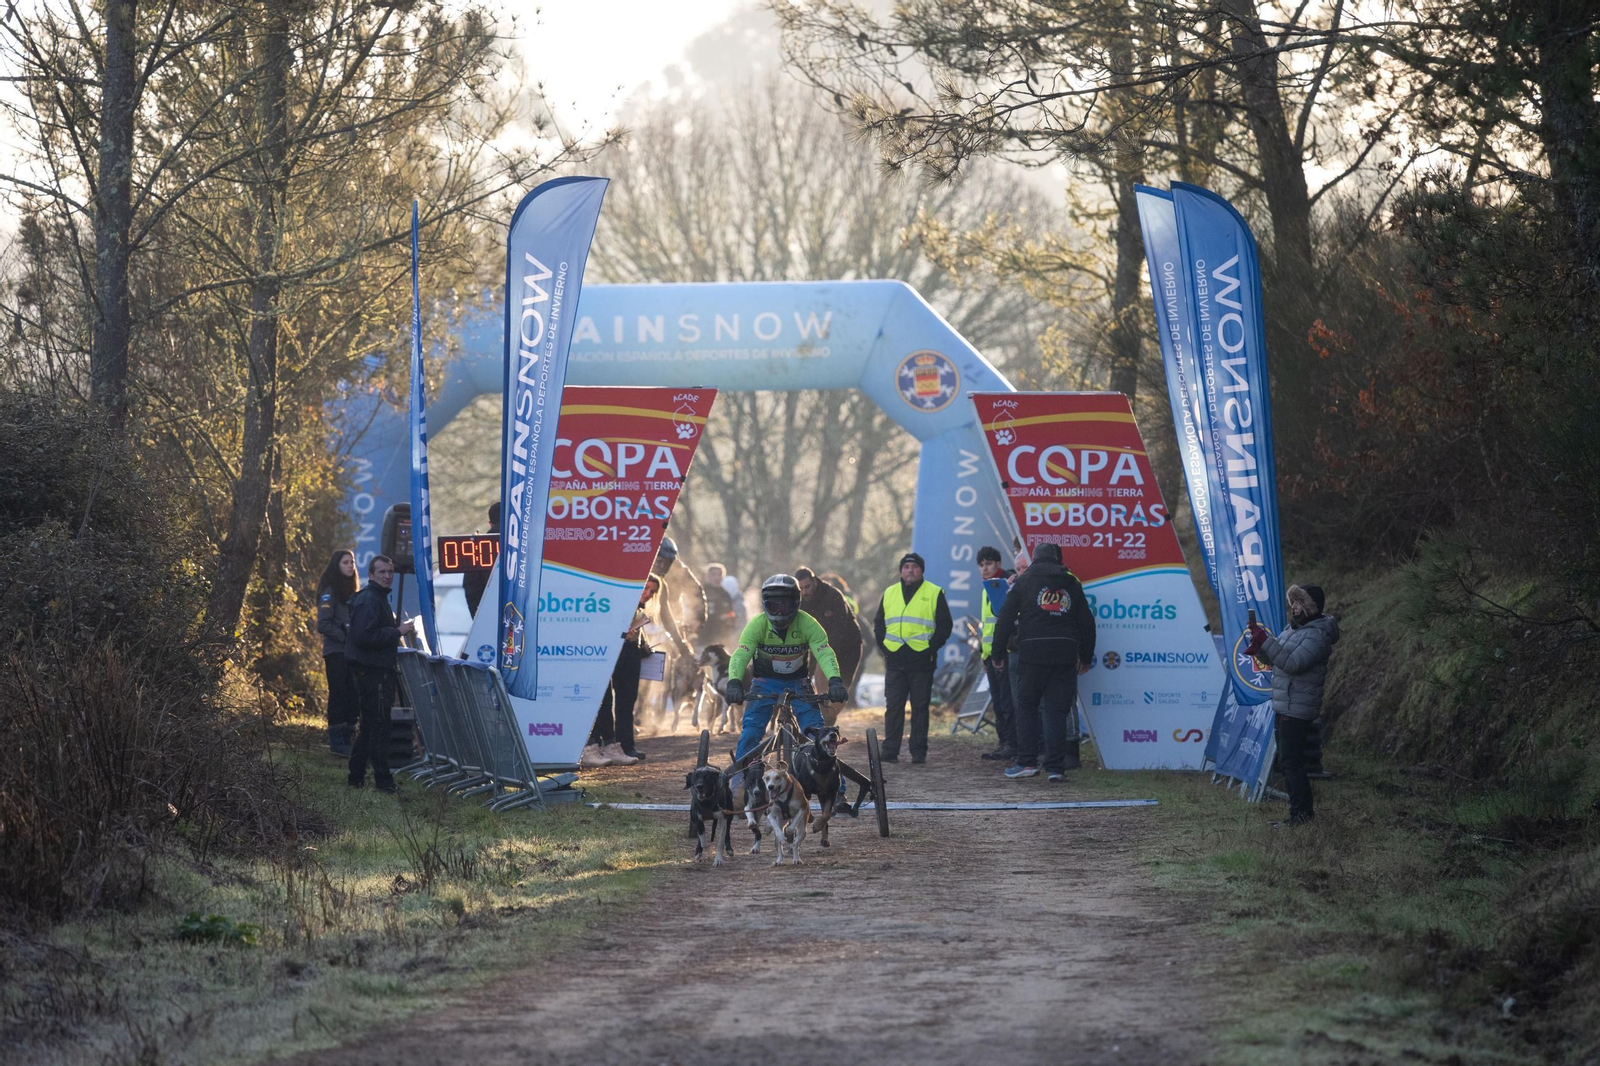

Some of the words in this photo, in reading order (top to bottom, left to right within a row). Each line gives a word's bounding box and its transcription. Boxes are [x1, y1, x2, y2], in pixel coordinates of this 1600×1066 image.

[551, 261, 568, 320] INVIERNO
[547, 322, 557, 340] DE
[752, 348, 769, 360] DE
[537, 342, 553, 406] DEPORTES
[673, 393, 700, 403] ACADE
[992, 400, 1019, 409] ACADE
[506, 252, 553, 581] SPAINSNOW
[529, 408, 543, 474] ESPAÑOLA
[552, 438, 682, 479] COPA
[1007, 445, 1145, 485] COPA
[592, 481, 640, 490] MUSHING
[643, 481, 681, 490] TIERRA
[1010, 486, 1051, 497] ESPAÑA
[1055, 488, 1103, 497] MUSHING
[1107, 488, 1144, 497] TIERRA
[521, 476, 534, 555] FEDERACIÓN
[1025, 501, 1165, 527] BOBORÁS
[545, 527, 596, 541] BRERO
[596, 525, 651, 541] 21-22
[1026, 533, 1091, 547] FEBRERO
[1092, 532, 1146, 547] 21-22
[622, 542, 652, 552] 2026
[1118, 549, 1146, 559] 2026
[518, 557, 527, 588] REAL
[1125, 652, 1209, 664] SPAINSNOW
